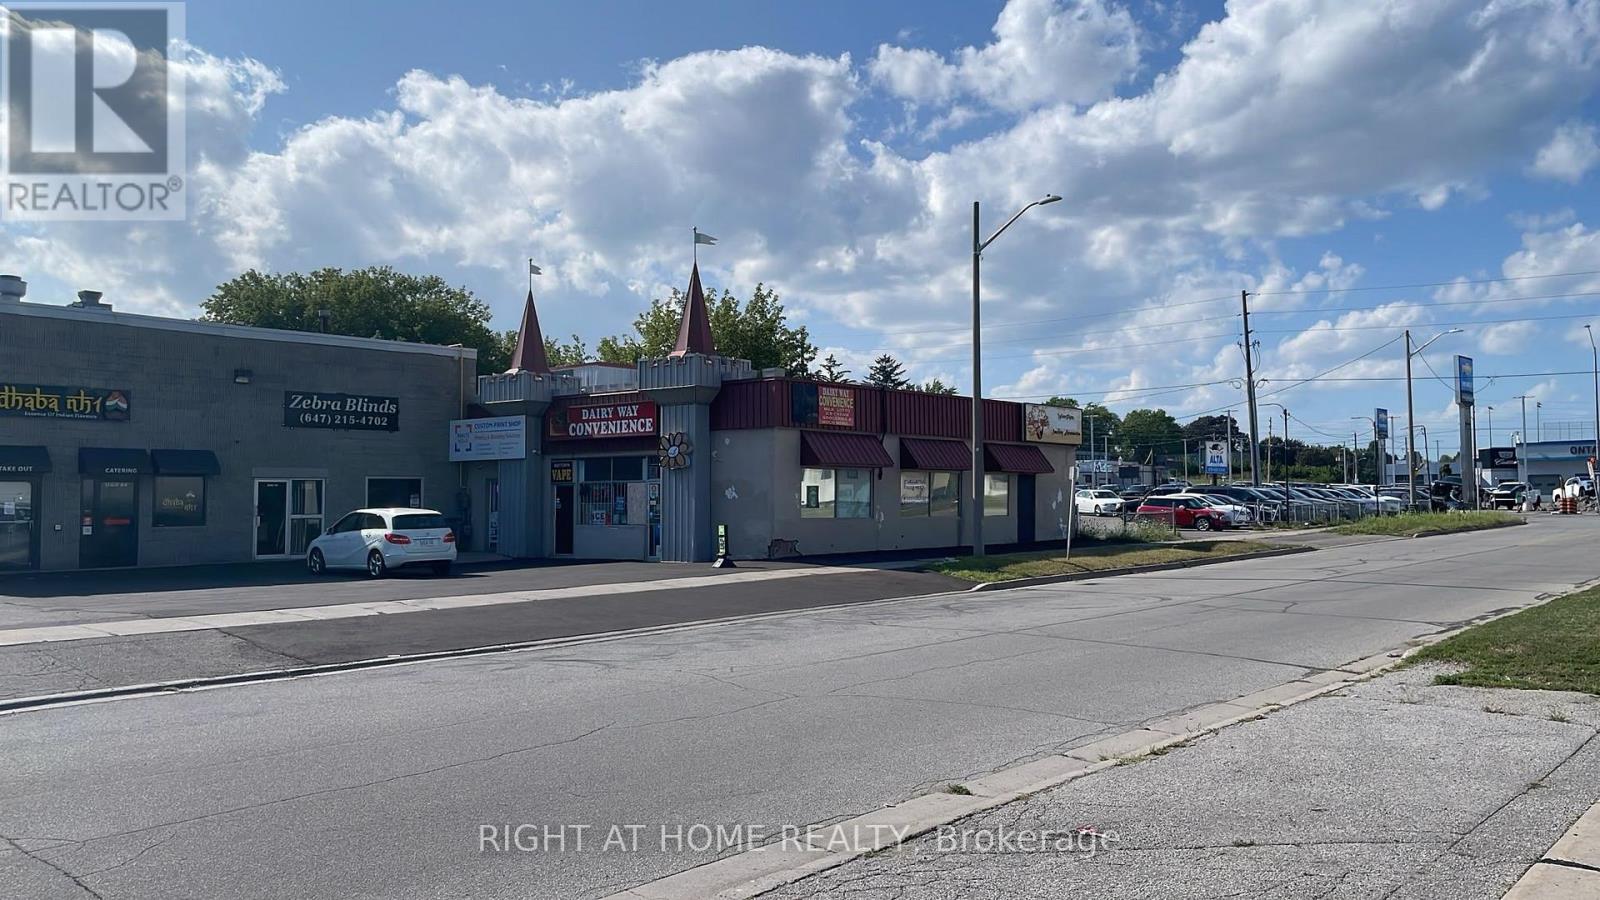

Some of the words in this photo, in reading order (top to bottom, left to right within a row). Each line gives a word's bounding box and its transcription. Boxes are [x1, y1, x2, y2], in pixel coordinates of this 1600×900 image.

[0, 386, 60, 411] dhaba
[822, 387, 838, 397] DAIRY
[839, 389, 849, 398] WAY
[289, 394, 341, 411] Zebra
[345, 398, 397, 414] Blinds
[819, 395, 854, 409] CONVENIENCE
[300, 413, 331, 425] (647)
[334, 414, 388, 426] 215-4702
[582, 408, 614, 420] DAIRY
[617, 405, 639, 417] WAY
[568, 418, 653, 437] CONVENIENCE
[1209, 455, 1224, 464] ALTA
[552, 469, 572, 481] VAPE
